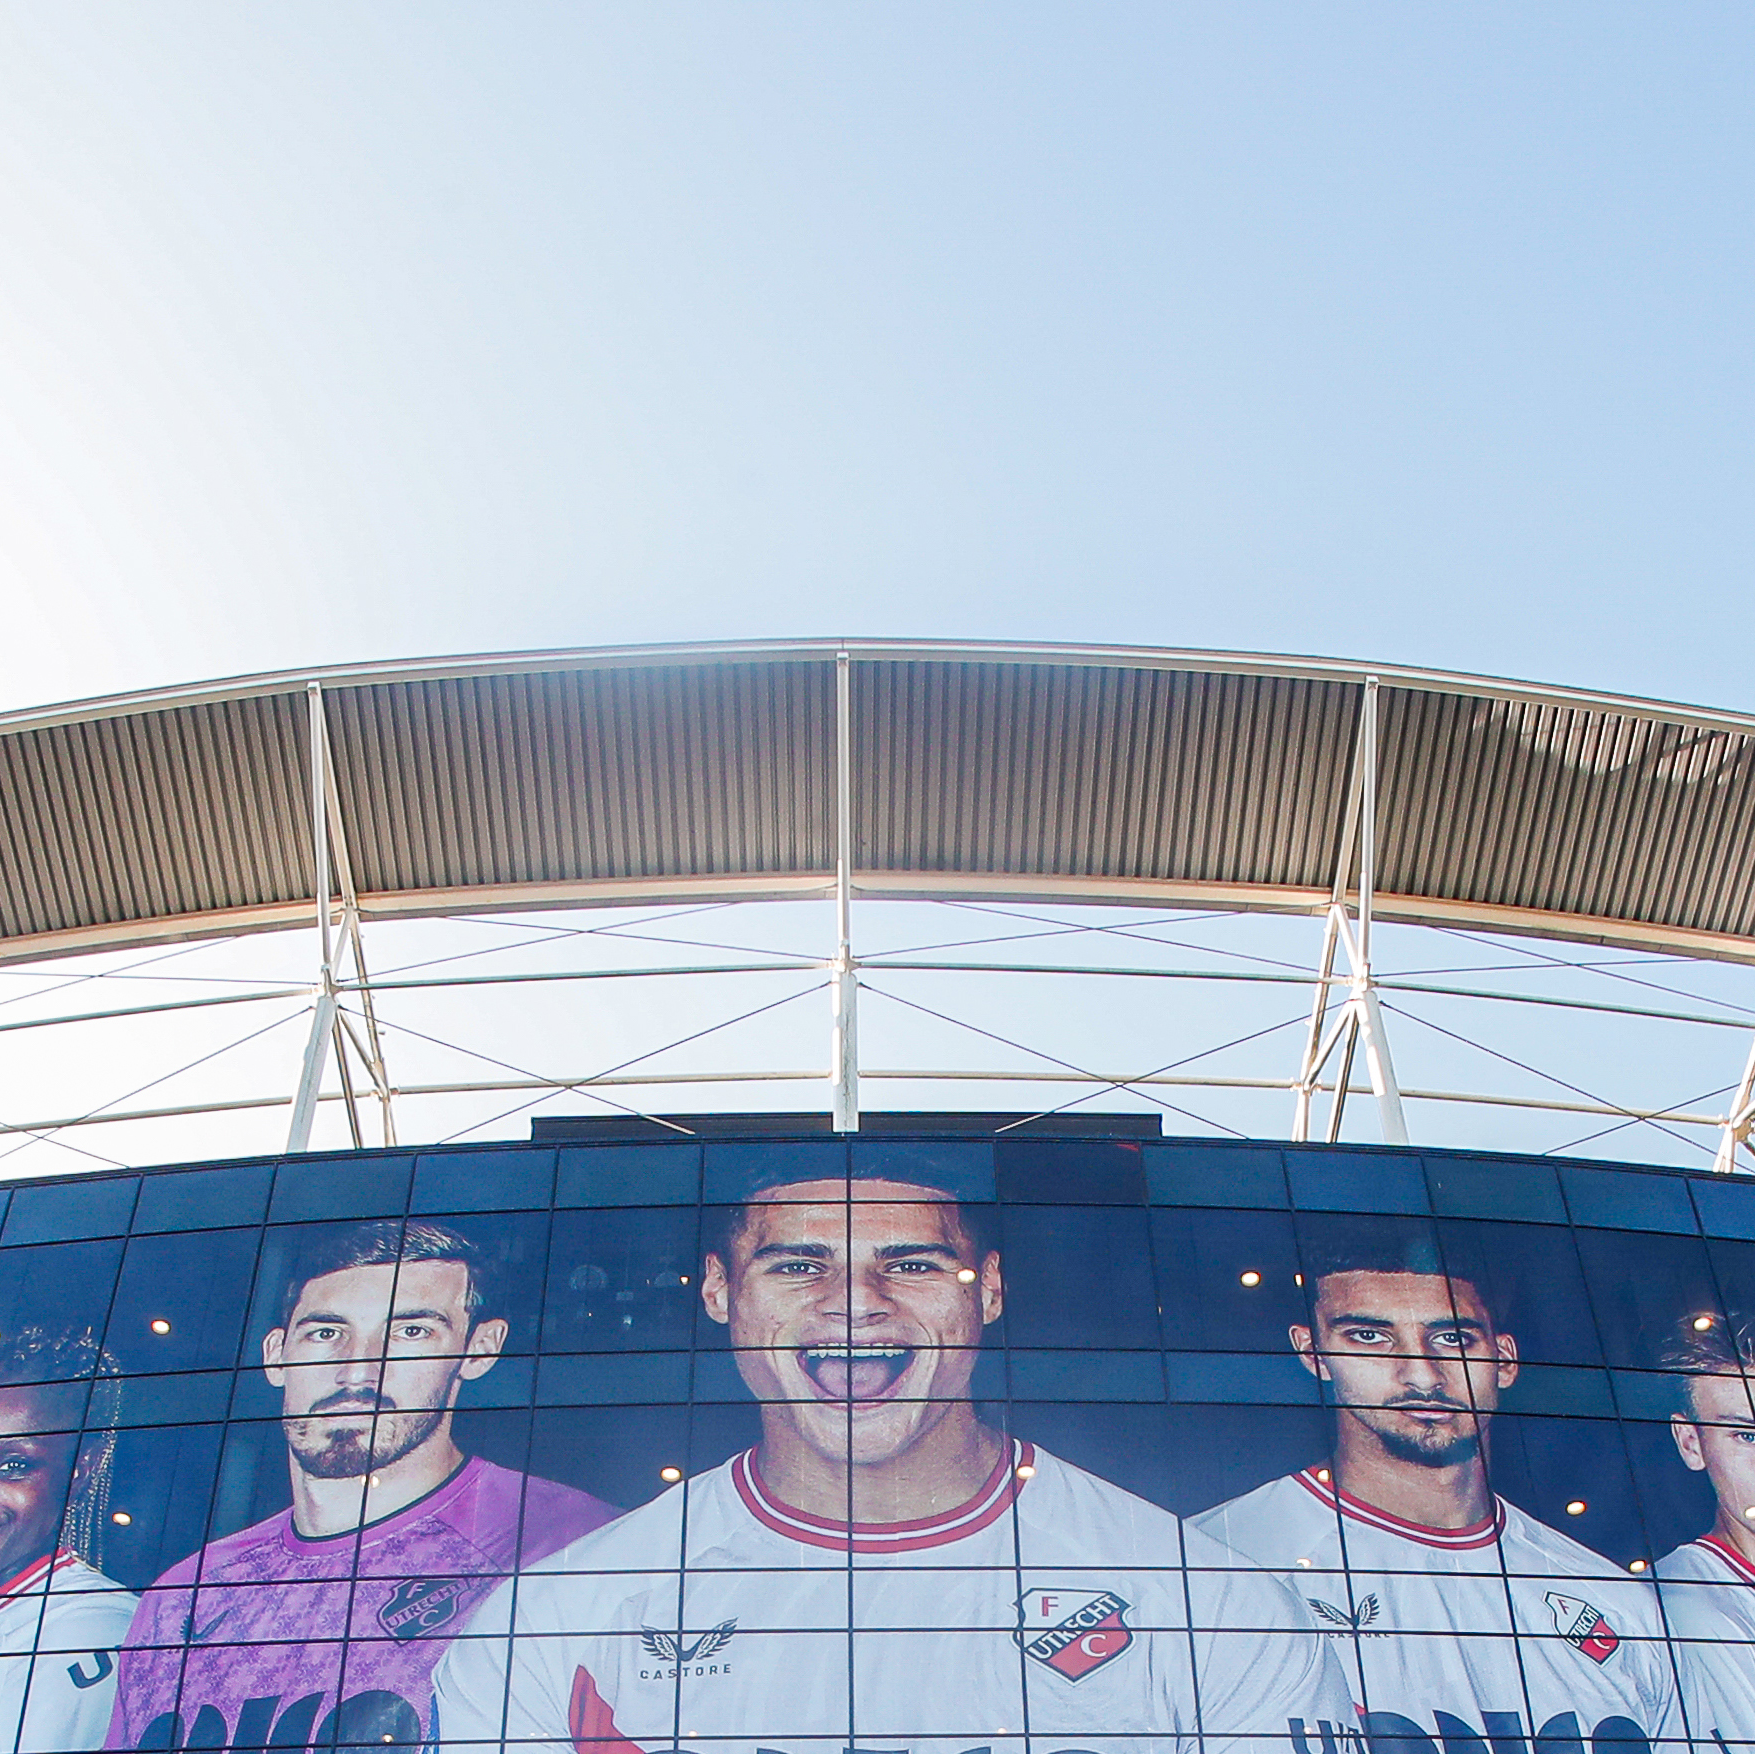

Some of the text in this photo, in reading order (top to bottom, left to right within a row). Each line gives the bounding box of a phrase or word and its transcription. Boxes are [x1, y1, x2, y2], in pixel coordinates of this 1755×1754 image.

[1041, 1596, 1059, 1617] F
[1028, 1595, 1120, 1659] UTRECHT
[640, 1664, 733, 1680] CASTORE
